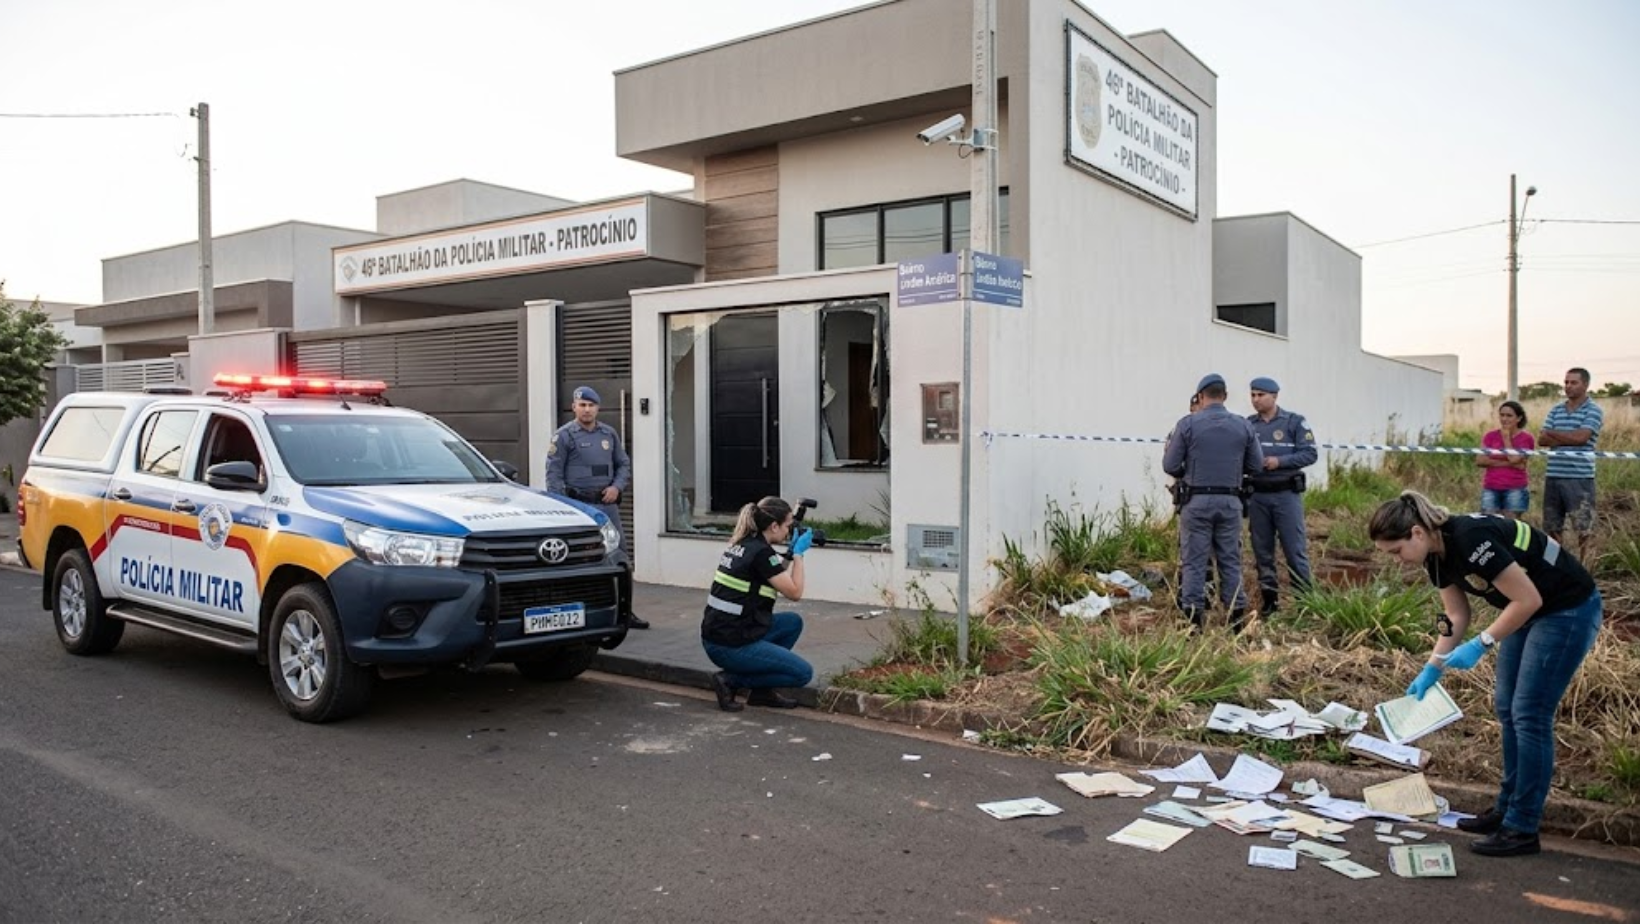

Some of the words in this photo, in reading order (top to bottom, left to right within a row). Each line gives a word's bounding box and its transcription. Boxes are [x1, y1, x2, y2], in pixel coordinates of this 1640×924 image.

[1107, 103, 1151, 148] POLÍCIA
[1153, 131, 1191, 171] MILITAR
[1180, 116, 1193, 143] DA
[1120, 145, 1180, 195] PATROCÍNIO
[378, 246, 431, 276] BATALHÃO
[433, 248, 448, 269] DA
[450, 236, 495, 267] POLÍCIA
[497, 232, 547, 260] MILITAR
[556, 215, 637, 251] PATROCÍNIO
[120, 555, 174, 597] POLÍCIA
[179, 569, 244, 613] MILITAR
